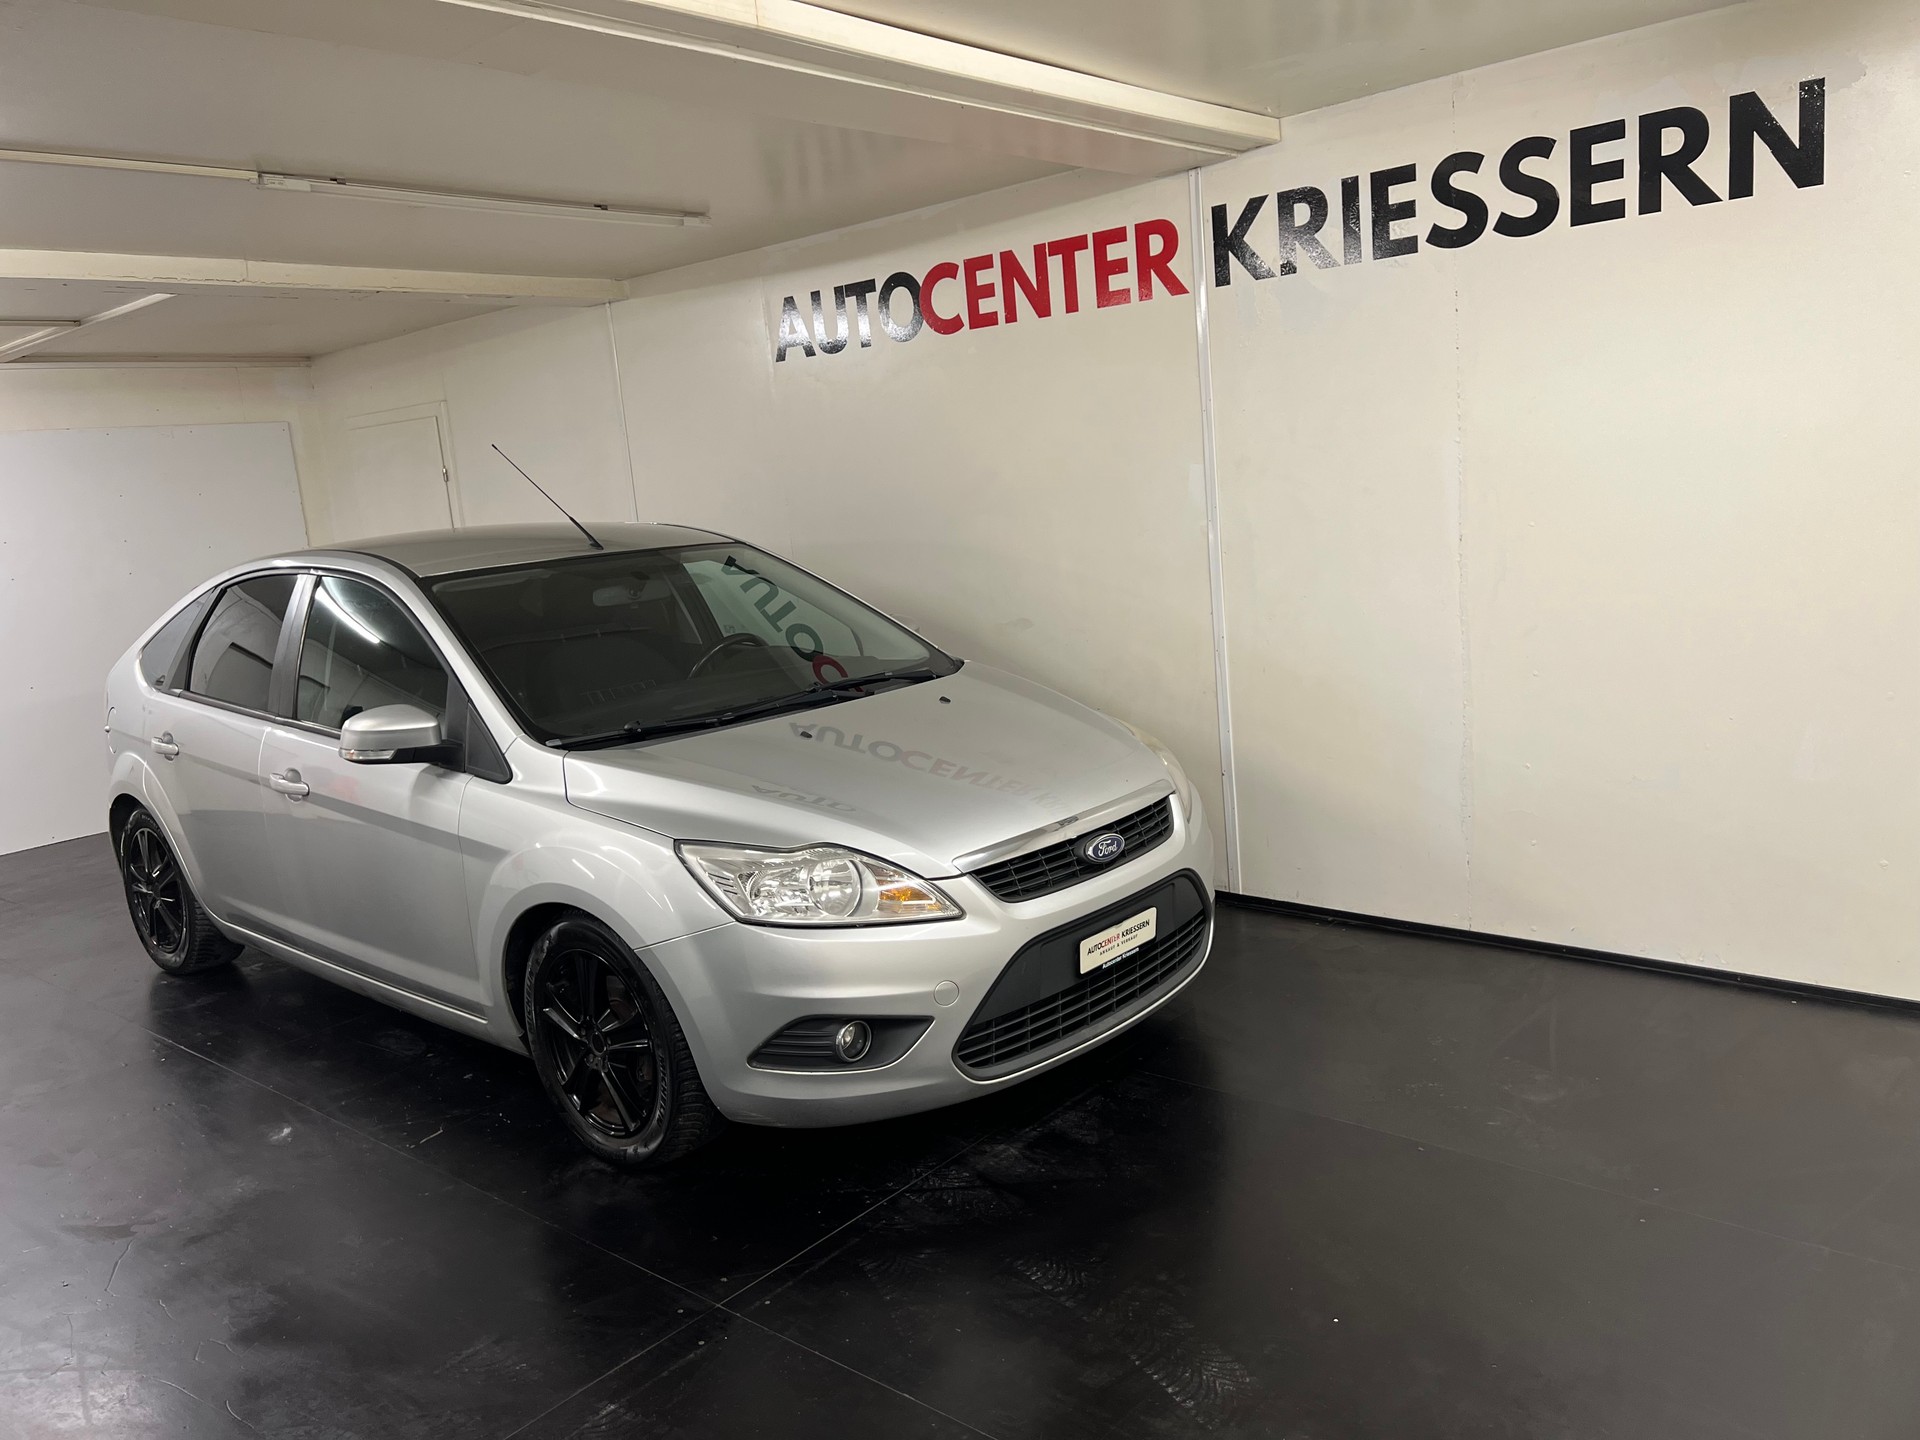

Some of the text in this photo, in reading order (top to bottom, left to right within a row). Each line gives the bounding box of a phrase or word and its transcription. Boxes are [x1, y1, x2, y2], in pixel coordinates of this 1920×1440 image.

[776, 77, 1825, 362] AUTOCENTER KRIESSERN
[1098, 840, 1117, 856] Ford
[1087, 919, 1150, 956] AUTOCENTER KRIESSERN
[1102, 947, 1139, 969] Autocenter Kriessern
